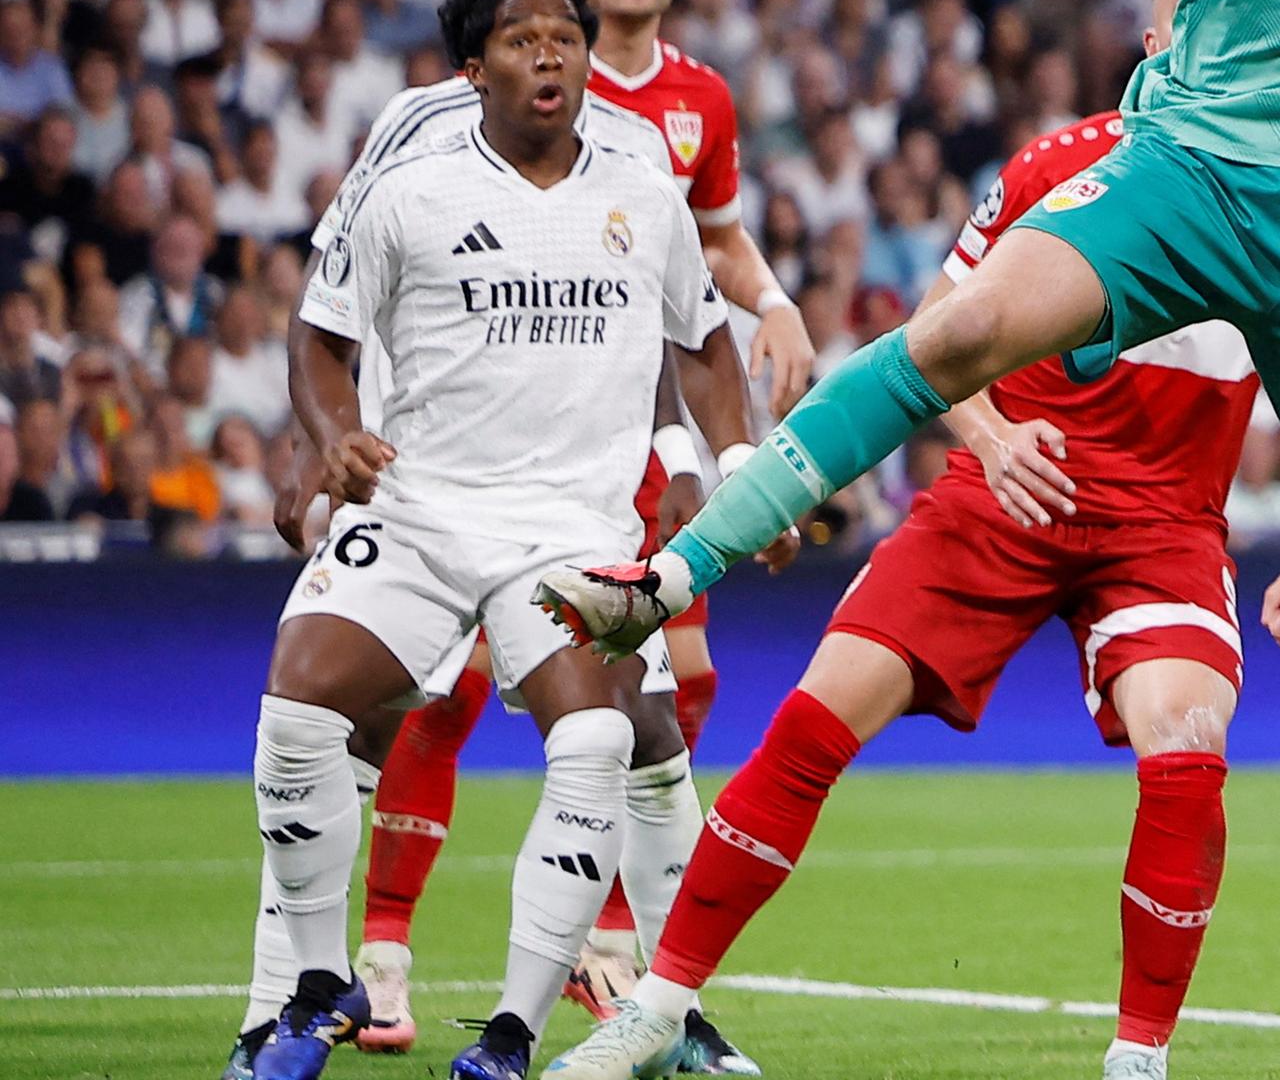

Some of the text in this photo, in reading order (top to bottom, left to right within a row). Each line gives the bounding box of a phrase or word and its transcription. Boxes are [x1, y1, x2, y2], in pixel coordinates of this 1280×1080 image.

[459, 270, 629, 312] Emirates
[486, 313, 606, 345] FLY BETTER
[556, 810, 615, 832] RMCF
